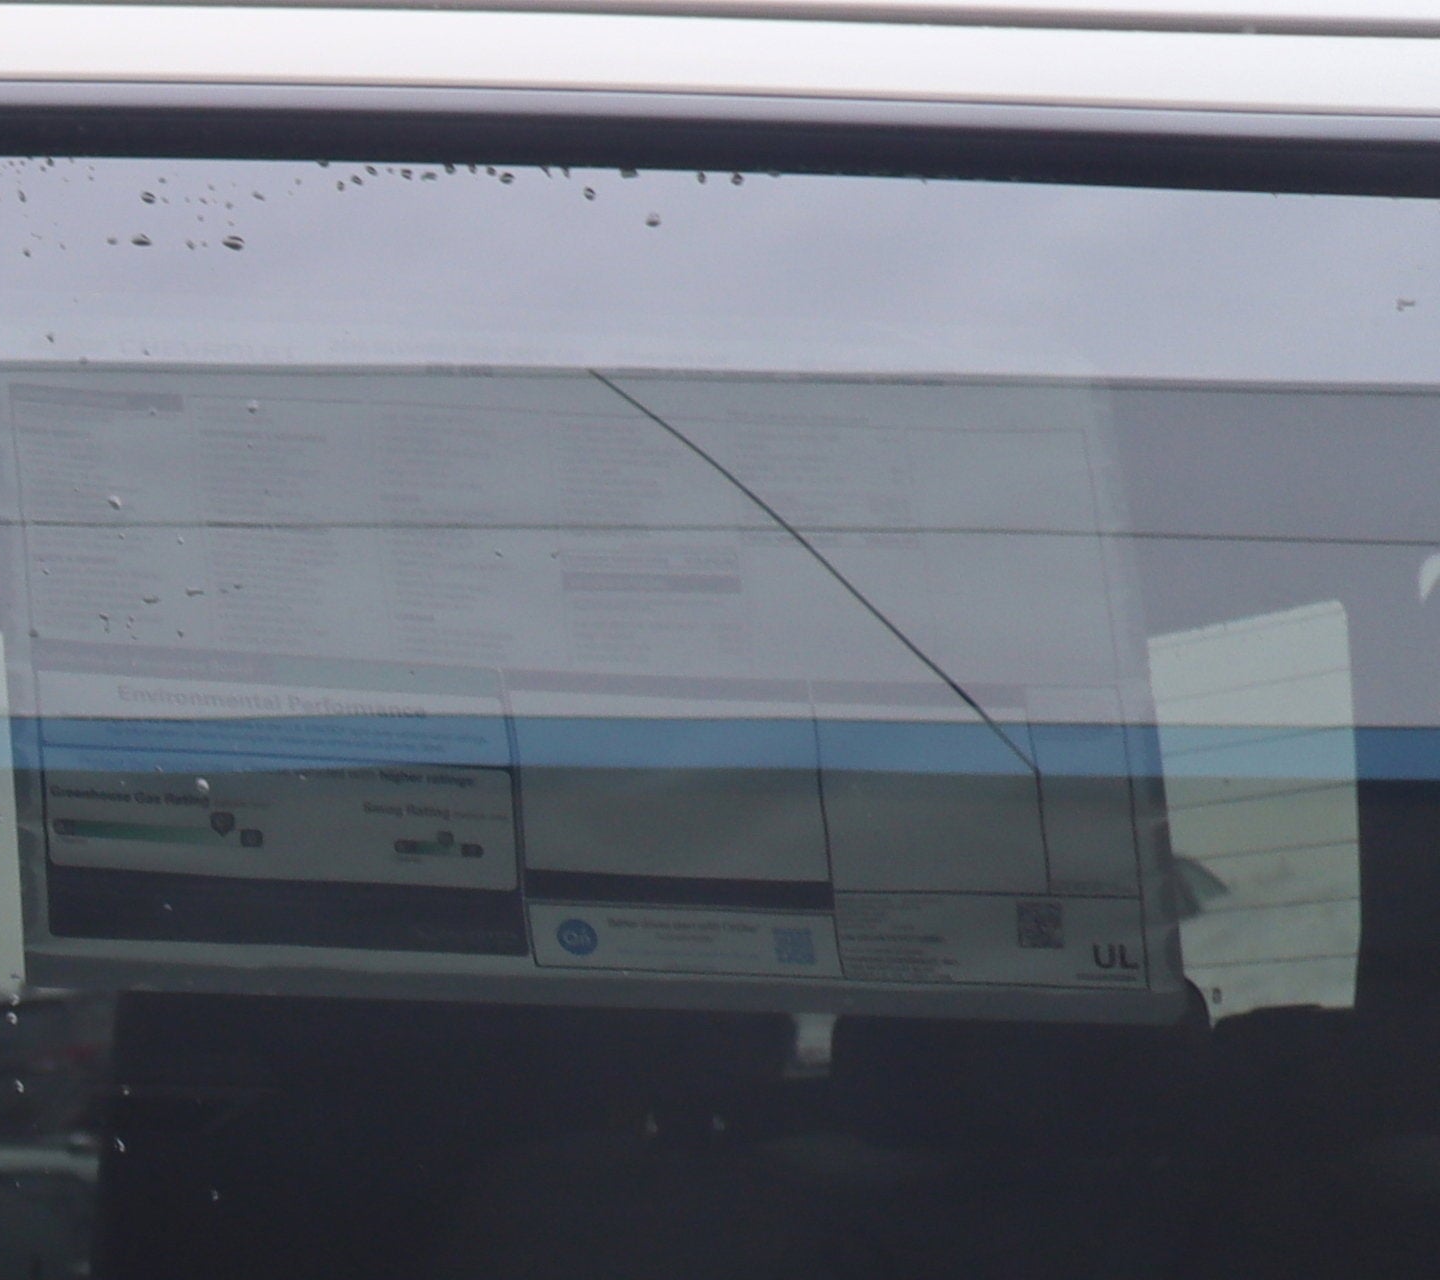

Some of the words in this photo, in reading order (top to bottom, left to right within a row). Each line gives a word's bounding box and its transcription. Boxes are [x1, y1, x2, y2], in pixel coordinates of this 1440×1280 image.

[118, 685, 281, 712] Environmental
[288, 694, 427, 718] Performance
[50, 785, 131, 803] Greenhouse
[134, 791, 161, 804] Gas
[164, 793, 209, 809] Rating
[406, 803, 450, 820] Rating
[1091, 943, 1140, 970] UL
